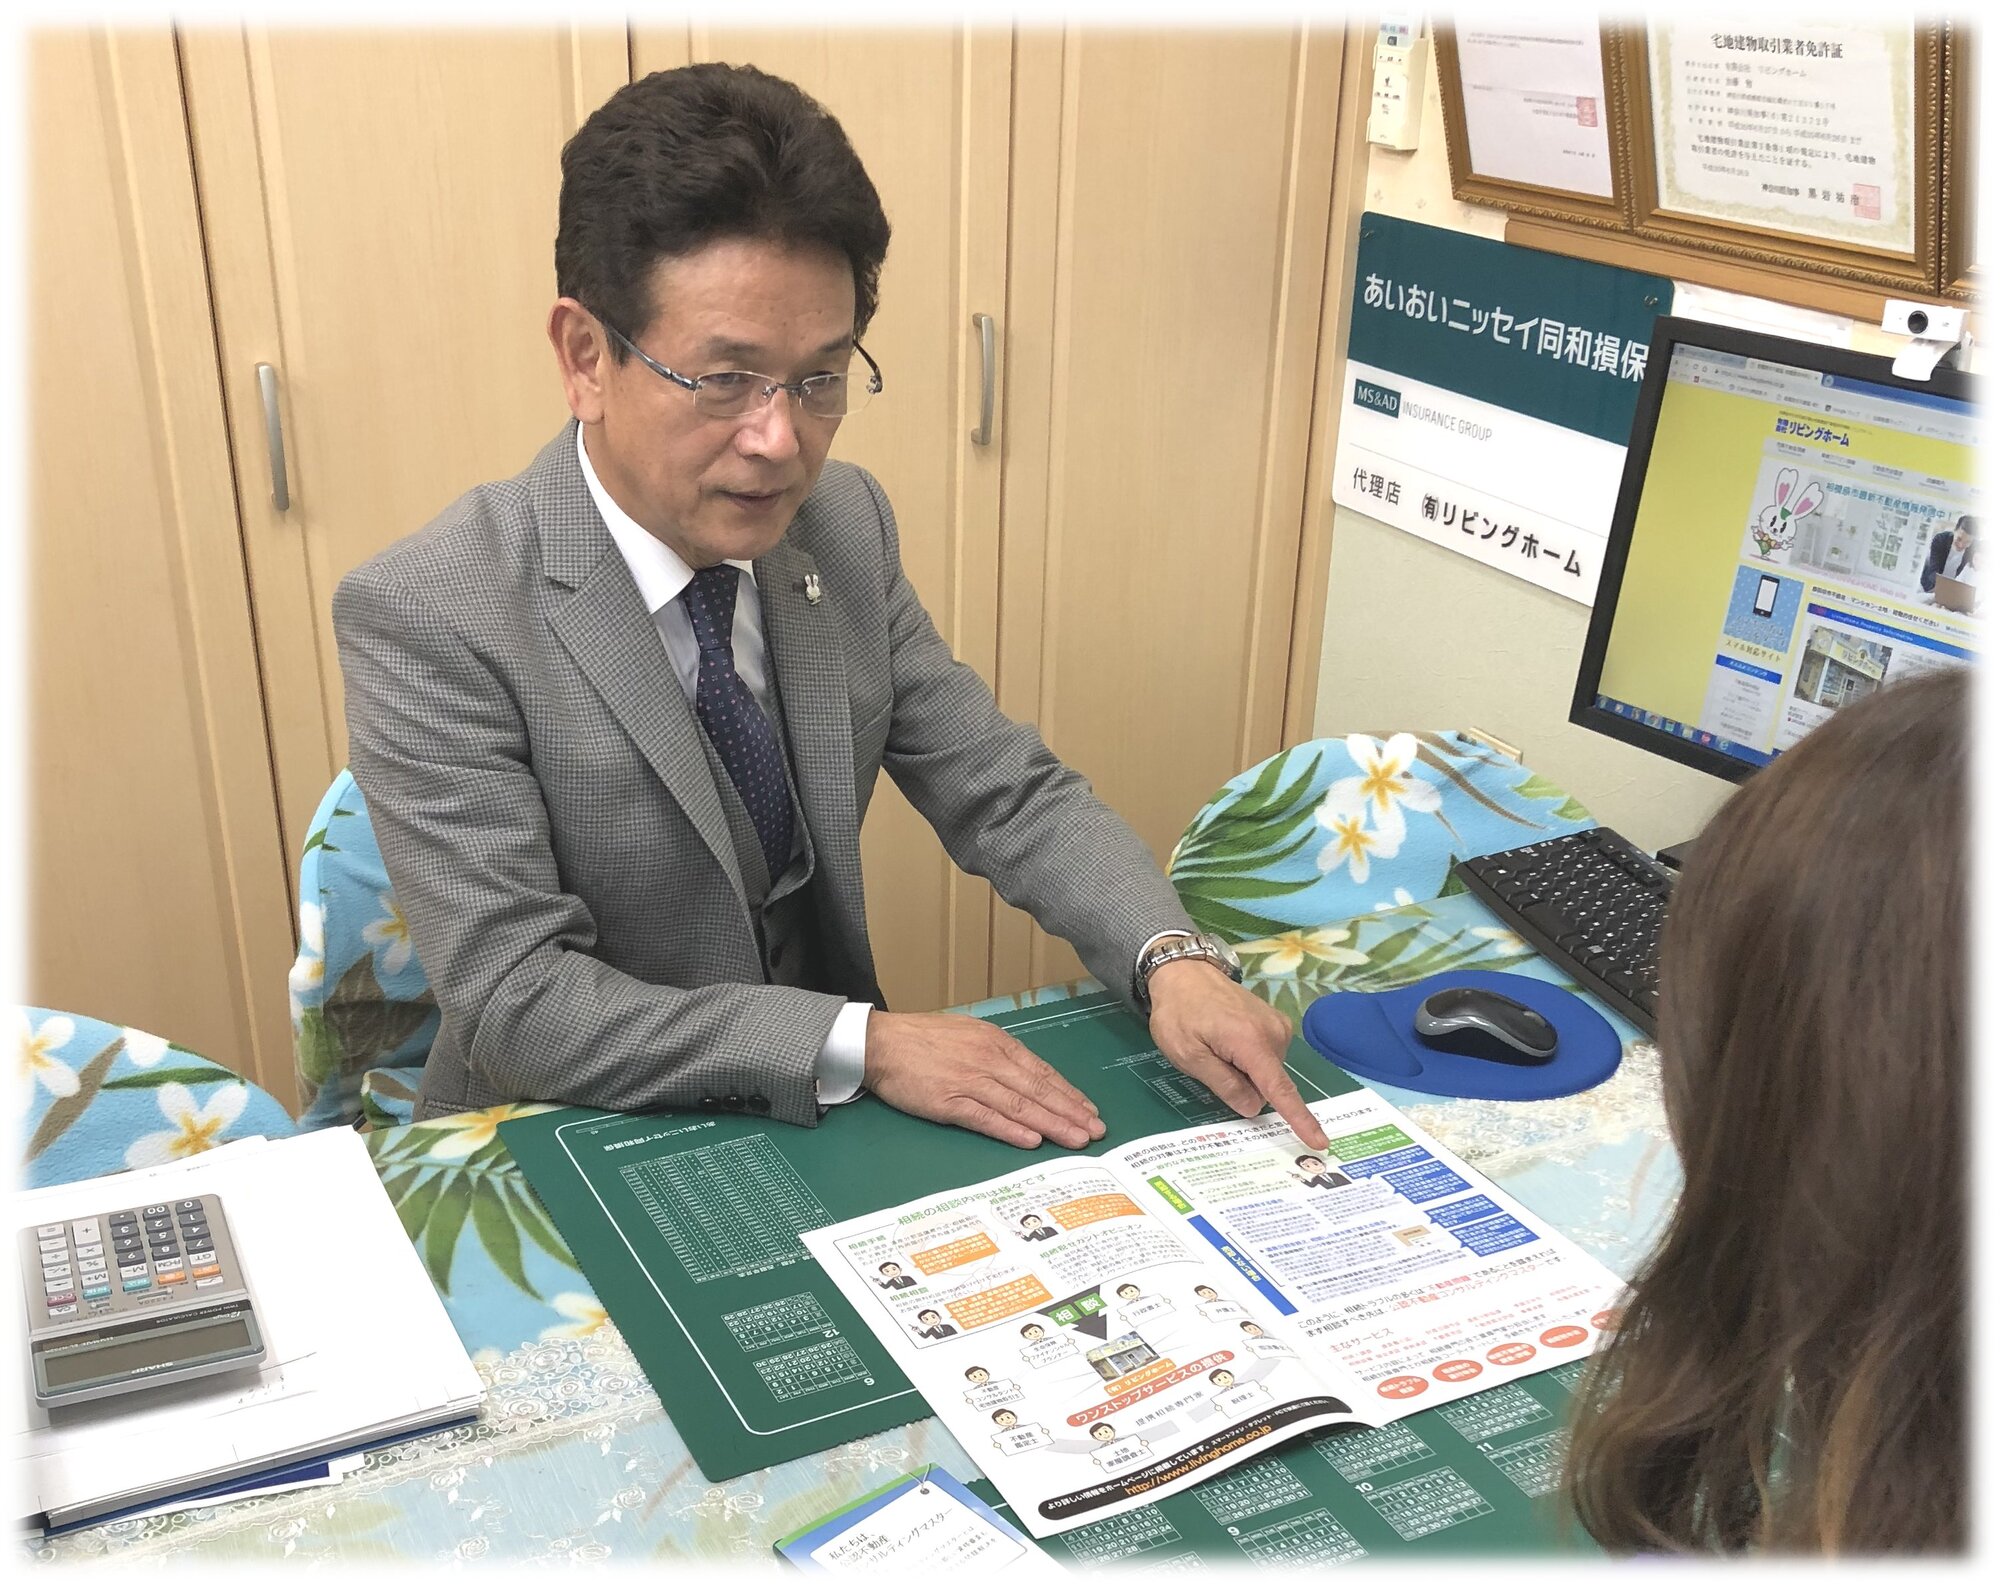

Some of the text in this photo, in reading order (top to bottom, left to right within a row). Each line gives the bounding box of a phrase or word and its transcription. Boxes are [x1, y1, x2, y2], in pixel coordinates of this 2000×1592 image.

[1711, 33, 1843, 59] 宅地建物取引業者免許証
[1363, 272, 1650, 383] あいおいニッセイ同和損保
[1356, 385, 1493, 442] MS&AD INSURANCE GROUP
[1789, 420, 1849, 447] リビングホーム
[1353, 467, 1402, 506] 代理店
[184, 1201, 193, 1209] 0
[898, 1174, 1046, 1227] 相続の相談内容は様々です
[147, 1206, 166, 1215] 00
[155, 1219, 164, 1227] 2
[120, 1226, 129, 1234] 3
[192, 1226, 200, 1234] 4
[196, 1239, 205, 1247] 7
[128, 1252, 136, 1260] 9
[195, 1253, 211, 1262] GT
[890, 1287, 929, 1302] 相続相談
[198, 1306, 221, 1316] POWER
[1056, 1294, 1101, 1322] 相談
[1132, 1302, 1161, 1317] 行政書士
[155, 1312, 199, 1324] CALCULATOR
[822, 1328, 840, 1338] 12
[1330, 1327, 1394, 1351] 主なサービス
[131, 1361, 174, 1375] SHARP
[1124, 1361, 1173, 1387] リビングホーム
[863, 1377, 875, 1386] 6
[1076, 1352, 1228, 1424] ワンストップサービスの提供
[1135, 1391, 1204, 1427] 提携相続専門家
[1009, 1431, 1034, 1442] 不動産
[1014, 1438, 1039, 1449] 鑑定士
[1476, 1442, 1494, 1452] 11
[1113, 1448, 1130, 1456] 土地
[1106, 1449, 1146, 1468] 家屋調査士
[1124, 1425, 1272, 1496] http://www.livinghome.co.jp
[1354, 1482, 1374, 1493] 10
[1227, 1526, 1240, 1536] 9
